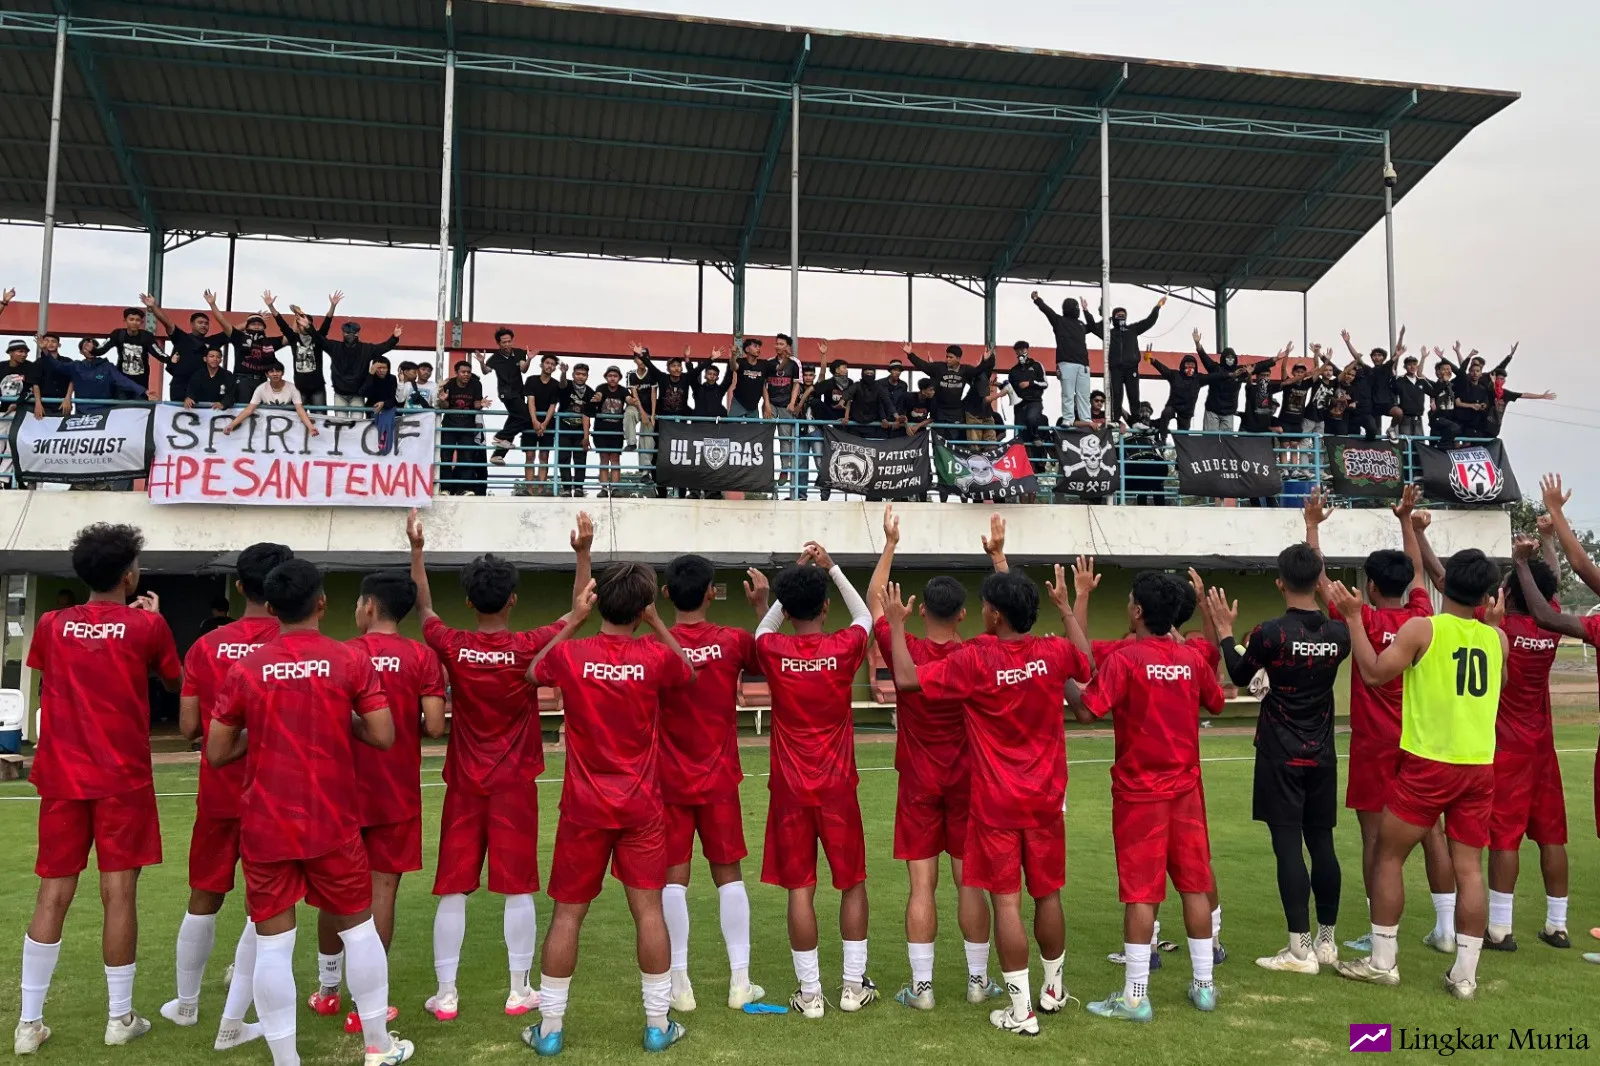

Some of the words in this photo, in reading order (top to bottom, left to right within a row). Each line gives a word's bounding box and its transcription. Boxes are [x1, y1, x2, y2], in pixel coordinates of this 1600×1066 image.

[72, 457, 113, 465] REGULER
[948, 460, 962, 474] 19
[1003, 456, 1017, 469] 51
[1190, 458, 1270, 477] RUDEBOYS
[148, 454, 434, 498] #PESANTENAN
[874, 476, 921, 490] SELATAN
[951, 485, 1025, 499] ATIFOSI
[1068, 481, 1085, 491] SB
[1100, 480, 1111, 491] 51
[62, 621, 126, 639] PERSIPA
[216, 642, 265, 660] PERS
[457, 648, 515, 665] PERSIPA
[682, 644, 722, 663] RSIPA
[1292, 641, 1338, 657] PERSIPA
[262, 659, 330, 682] PERSIPA
[371, 656, 401, 673] SIPA
[583, 661, 645, 681] PERSIPA
[782, 656, 837, 672] PERSIPA
[1146, 664, 1191, 681] PERSIPA
[1452, 646, 1488, 697] 10
